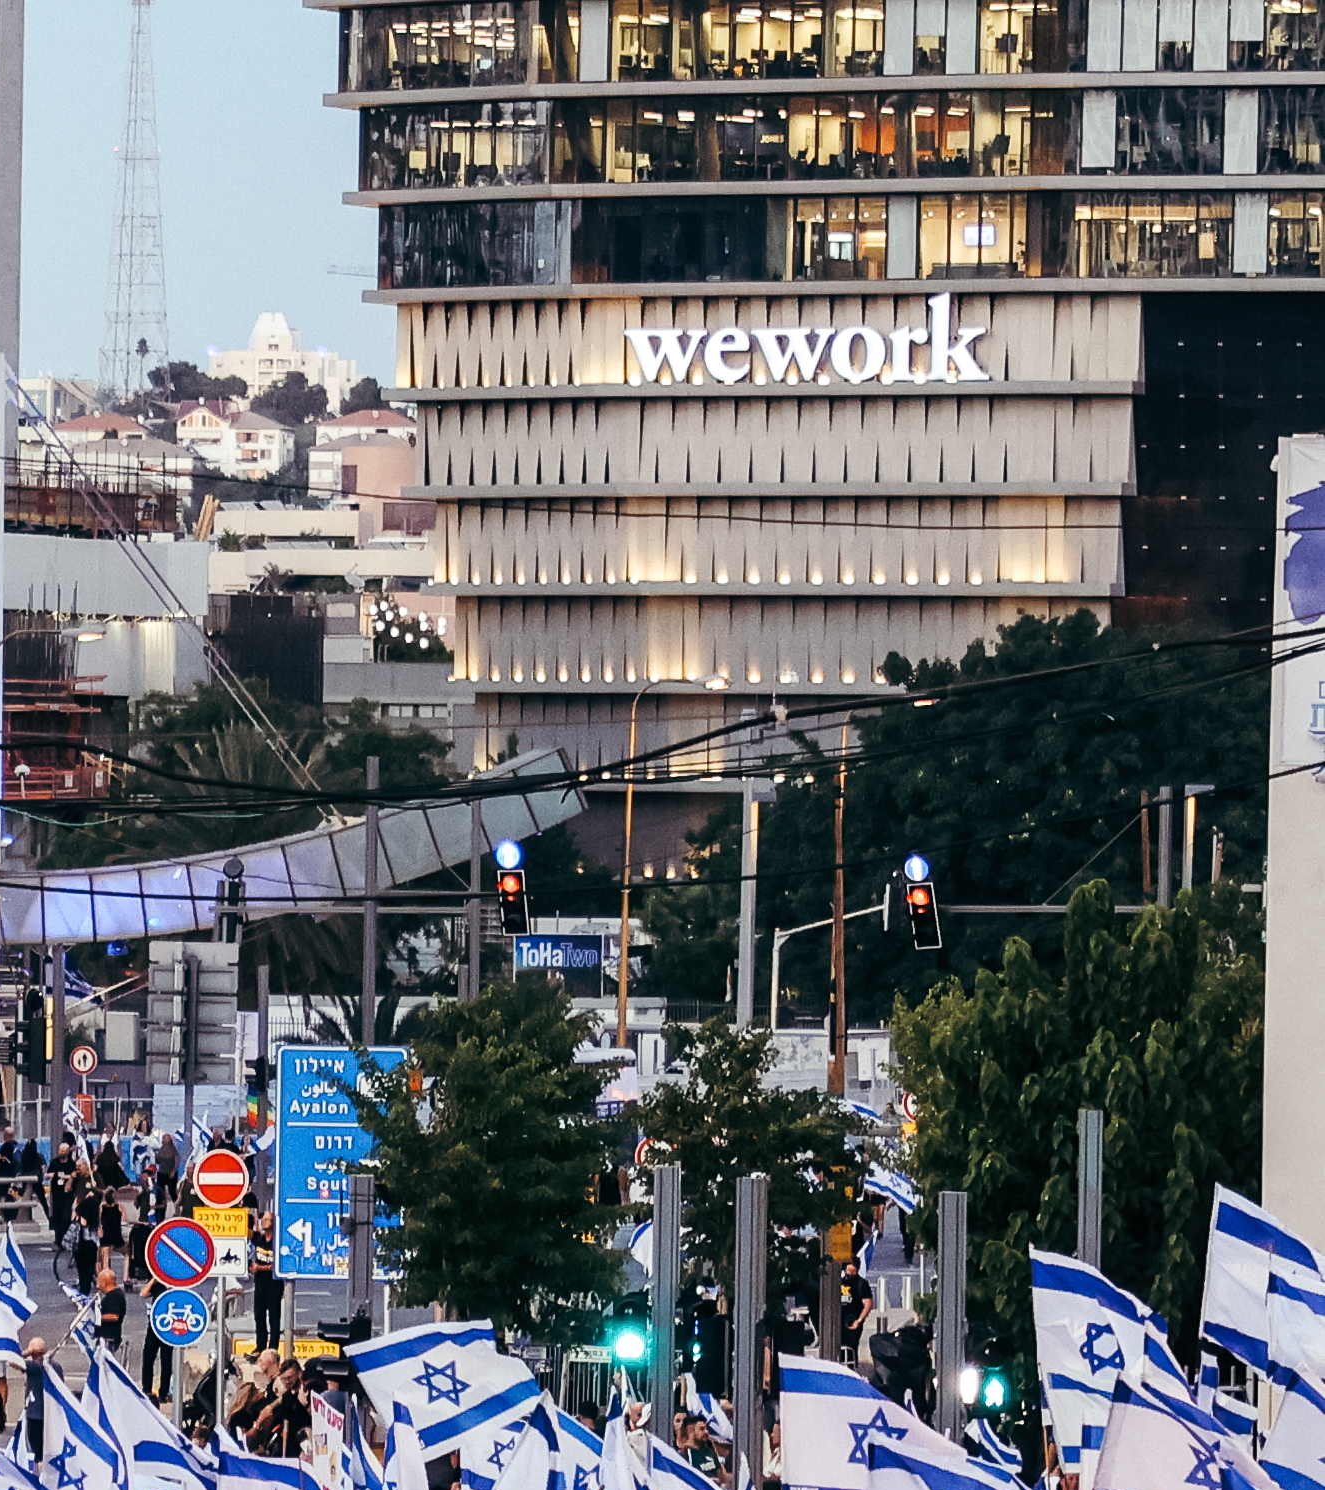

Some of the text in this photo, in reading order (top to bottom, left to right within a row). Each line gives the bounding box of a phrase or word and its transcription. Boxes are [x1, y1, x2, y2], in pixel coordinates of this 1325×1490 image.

[624, 291, 991, 384] wework
[294, 1056, 345, 1075] איילון
[290, 1099, 349, 1117] Ayalon
[314, 1135, 353, 1150] דרום
[307, 1176, 348, 1191] Sout
